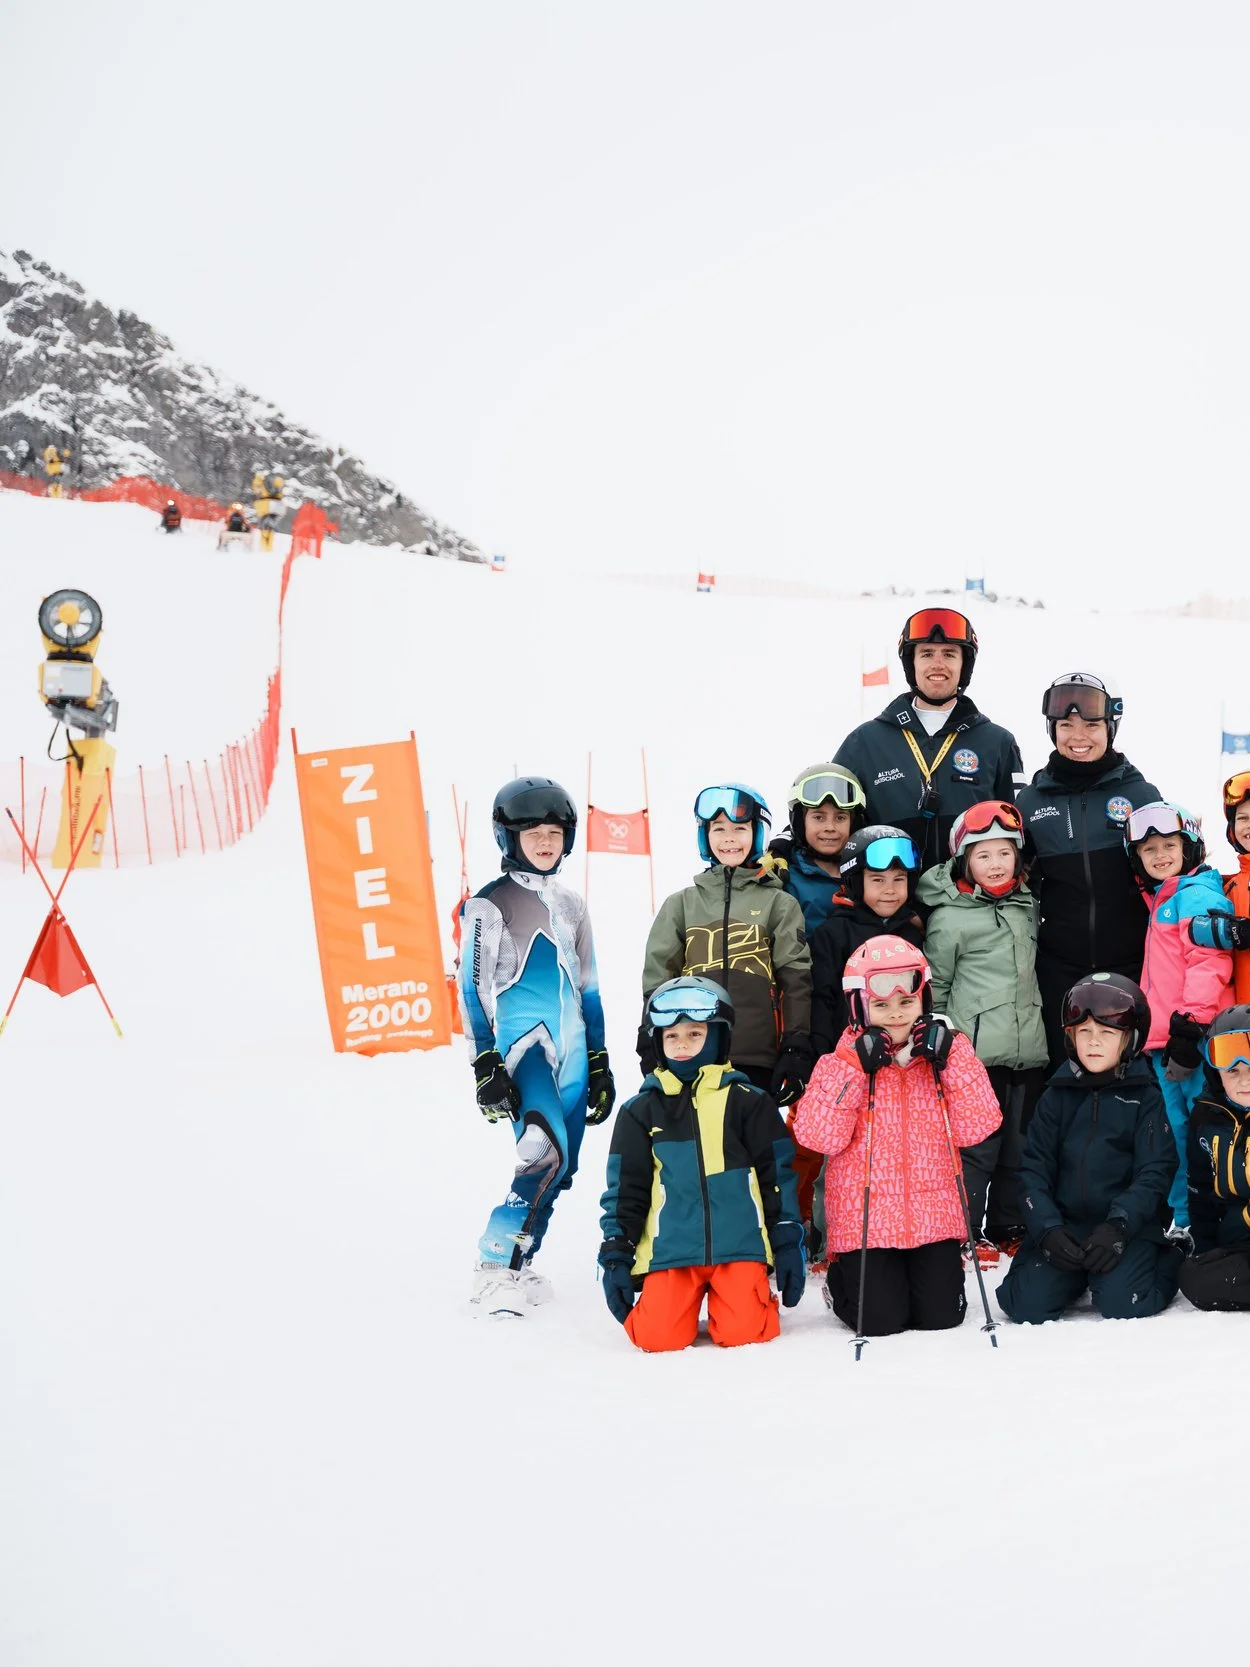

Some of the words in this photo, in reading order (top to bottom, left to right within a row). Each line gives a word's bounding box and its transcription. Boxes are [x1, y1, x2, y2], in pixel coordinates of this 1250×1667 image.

[874, 772, 905, 786] SKISCHOOL
[877, 767, 899, 778] ALTURA
[1029, 810, 1061, 823] SKISCHOOL
[1034, 804, 1057, 815] ALTURA
[340, 763, 397, 961] ZIEL
[1231, 926, 1241, 945] LEKI
[471, 917, 483, 987] ENERGIAPURA
[341, 979, 429, 1005] Merano
[344, 997, 432, 1033] 2000
